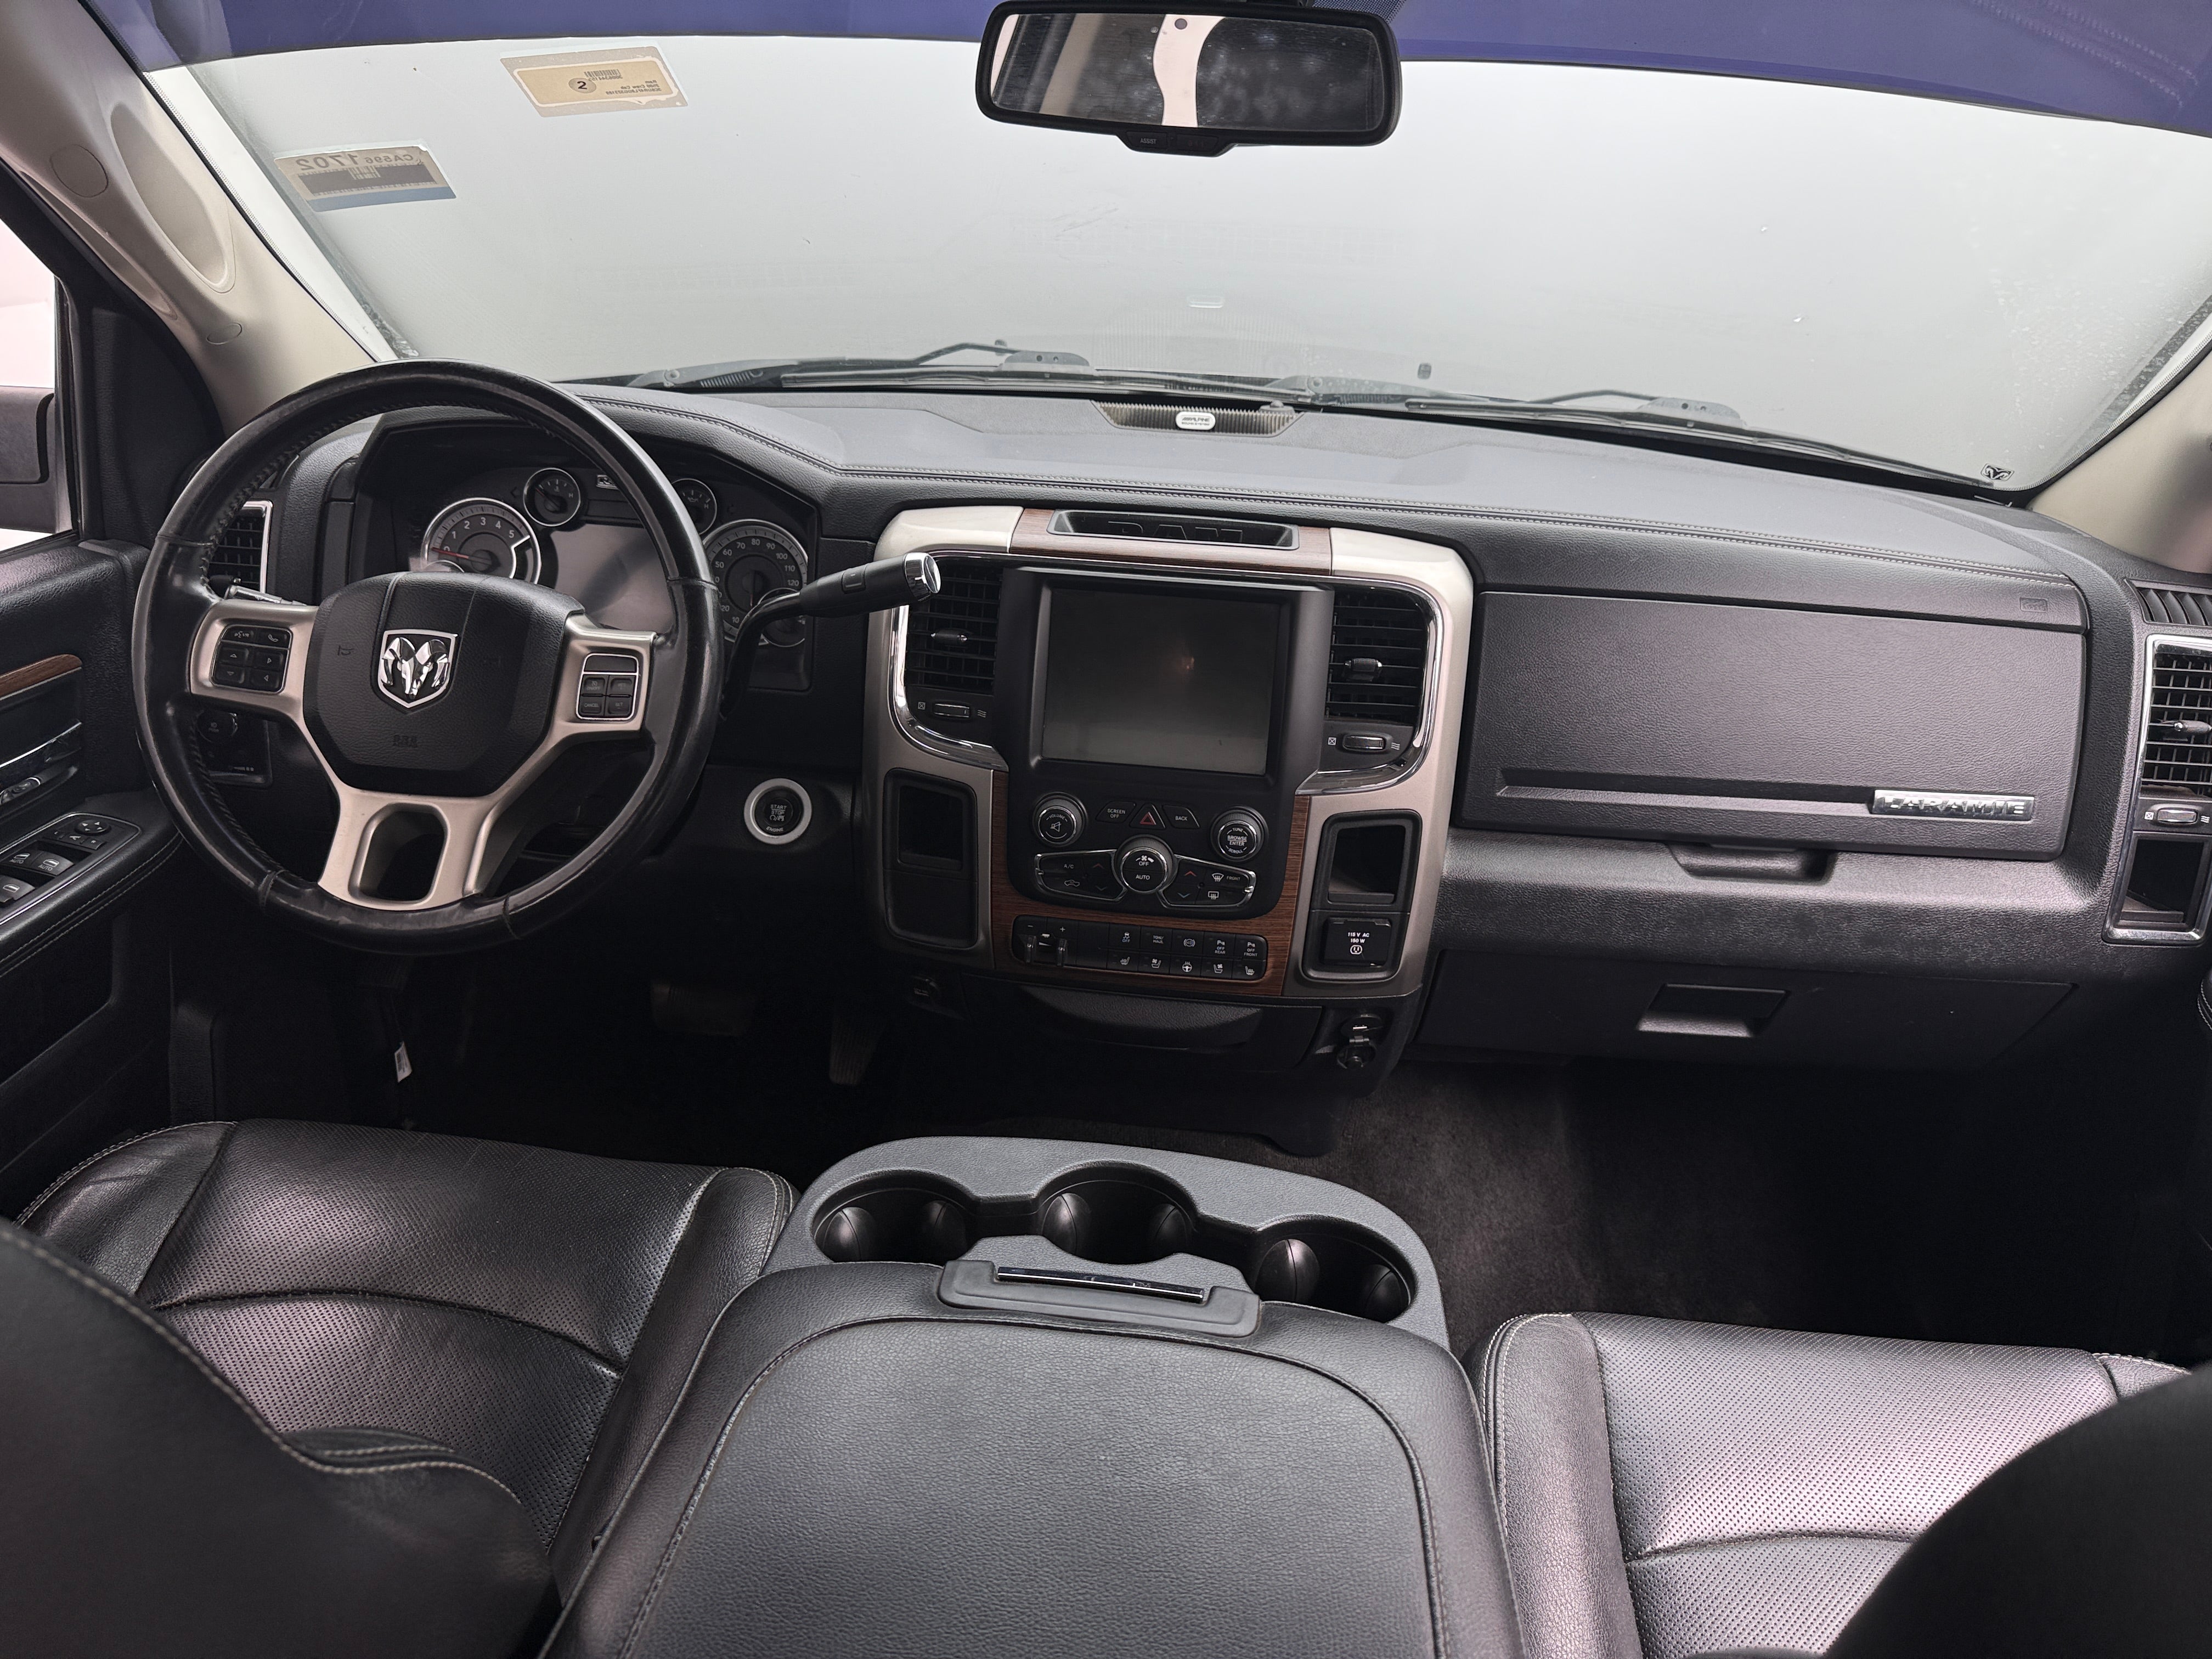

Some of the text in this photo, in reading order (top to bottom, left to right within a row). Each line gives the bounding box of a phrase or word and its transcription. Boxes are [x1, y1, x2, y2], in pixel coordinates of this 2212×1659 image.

[577, 81, 588, 89] 2
[464, 521, 470, 529] 2
[481, 517, 487, 526] 3
[495, 520, 502, 529] 4
[509, 530, 515, 539] 5
[723, 549, 732, 557] 60
